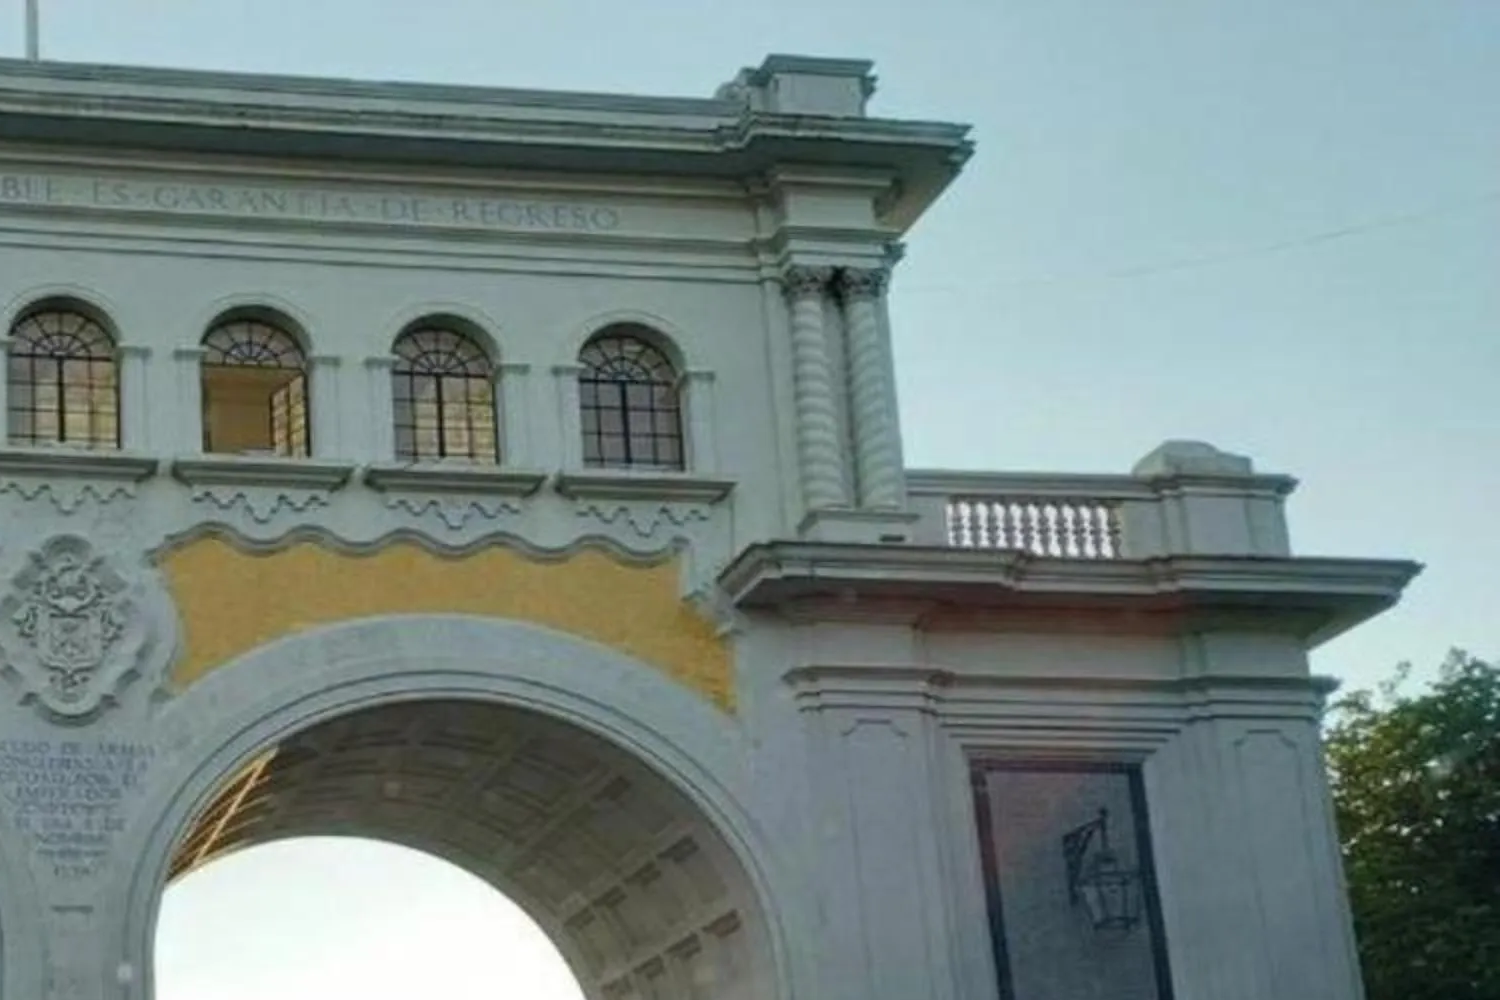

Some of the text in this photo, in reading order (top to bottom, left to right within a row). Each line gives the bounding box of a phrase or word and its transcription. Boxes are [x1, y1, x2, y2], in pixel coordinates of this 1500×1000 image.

[91, 180, 130, 205] ES
[380, 197, 434, 222] DE
[452, 200, 621, 231] REGRESO
